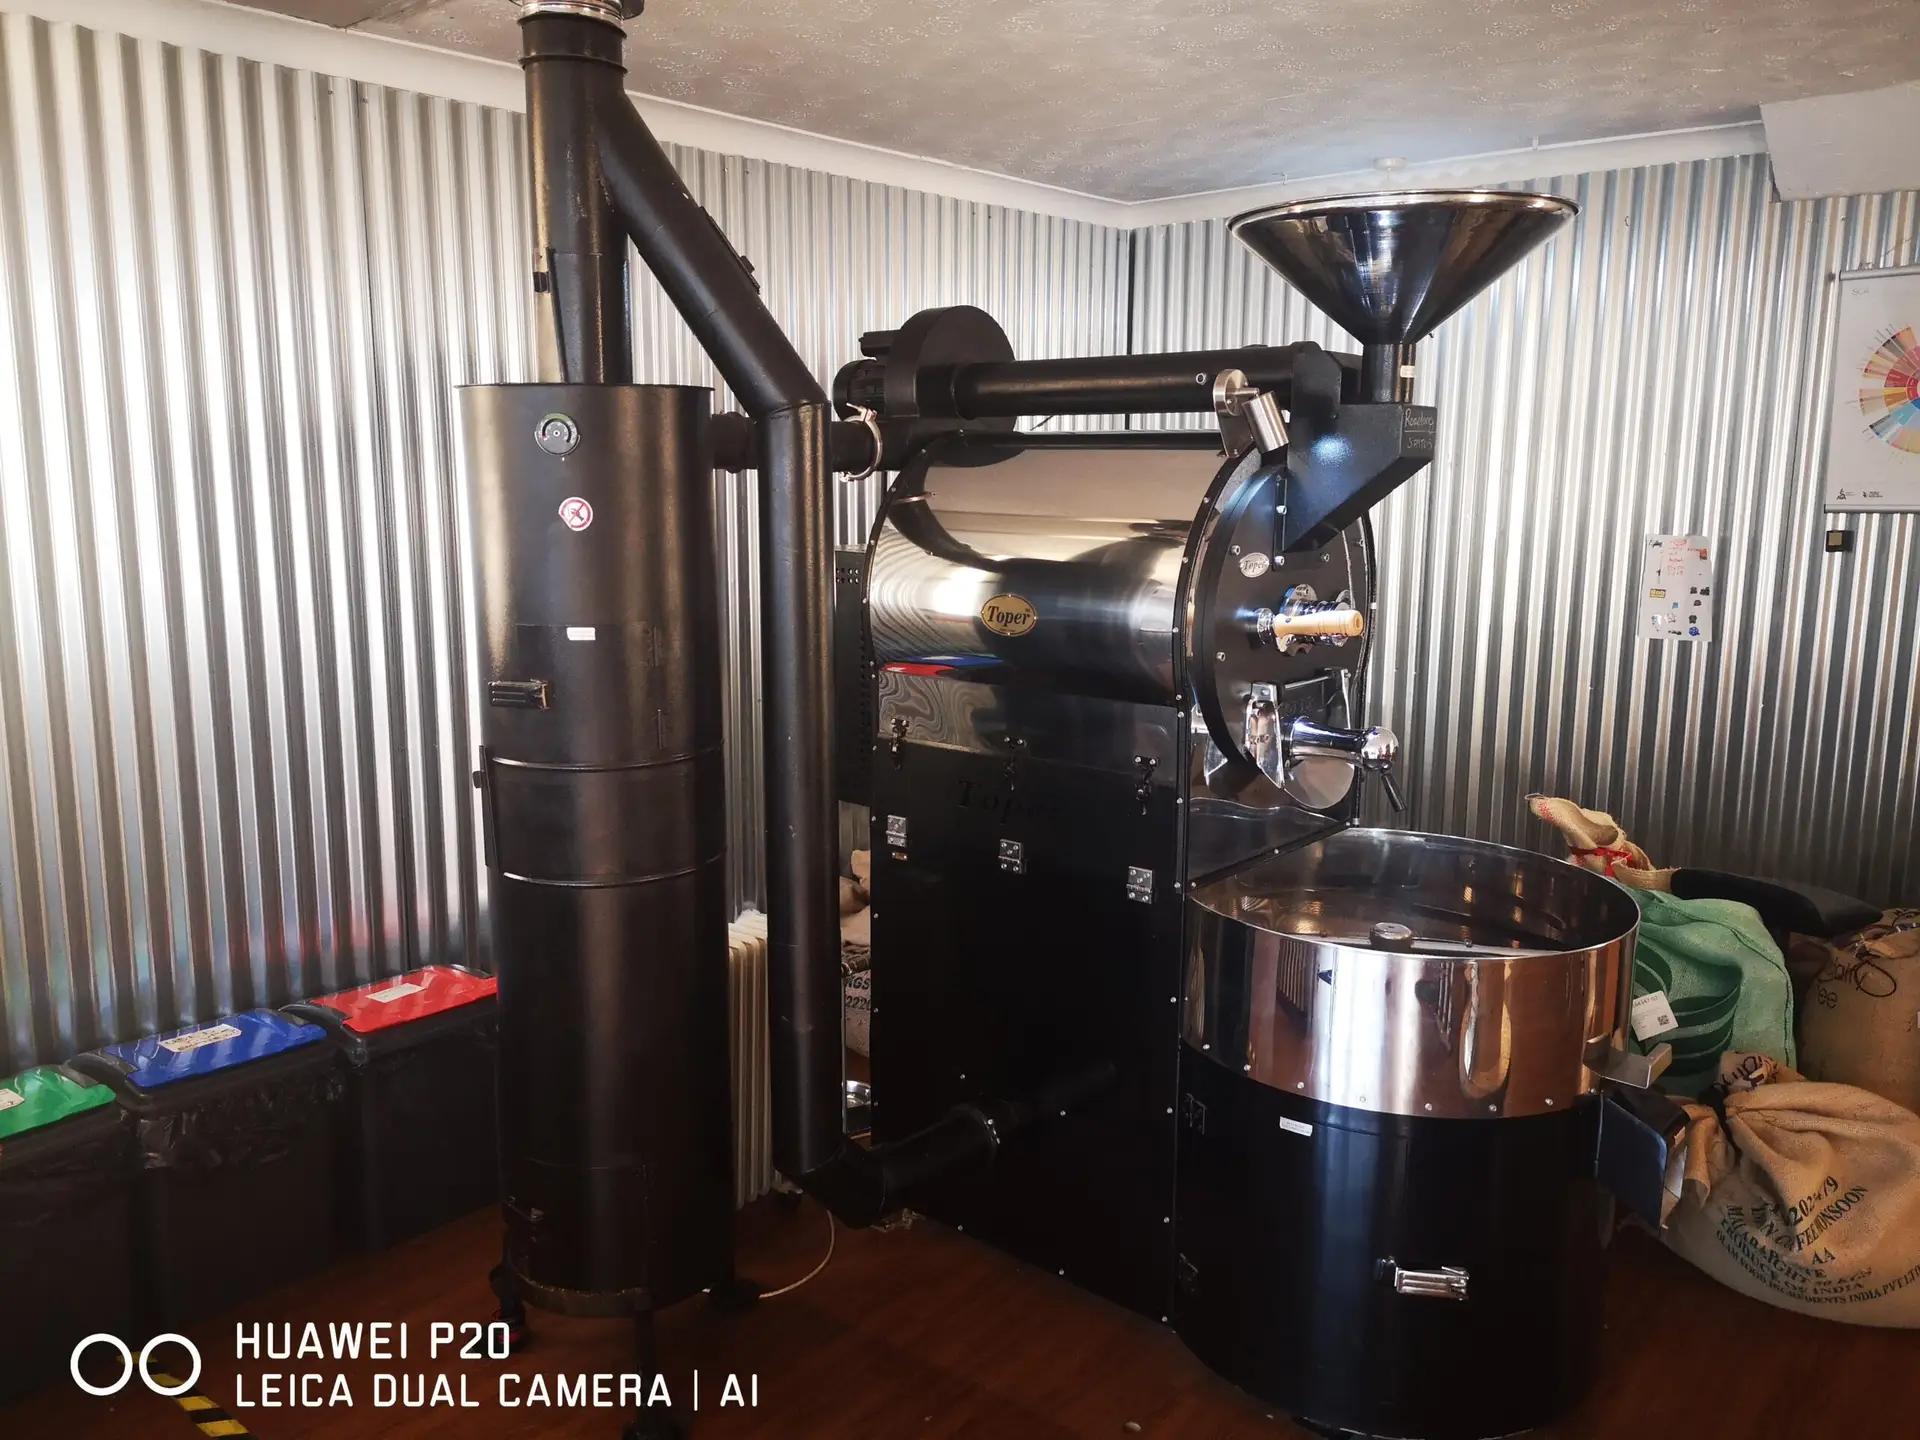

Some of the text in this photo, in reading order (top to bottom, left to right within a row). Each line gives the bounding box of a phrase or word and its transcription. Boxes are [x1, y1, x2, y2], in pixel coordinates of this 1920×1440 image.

[1243, 561, 1265, 573] Toper
[987, 605, 1031, 627] Toper
[1812, 1247, 1836, 1265] AA
[1882, 1278, 1904, 1296] PVT
